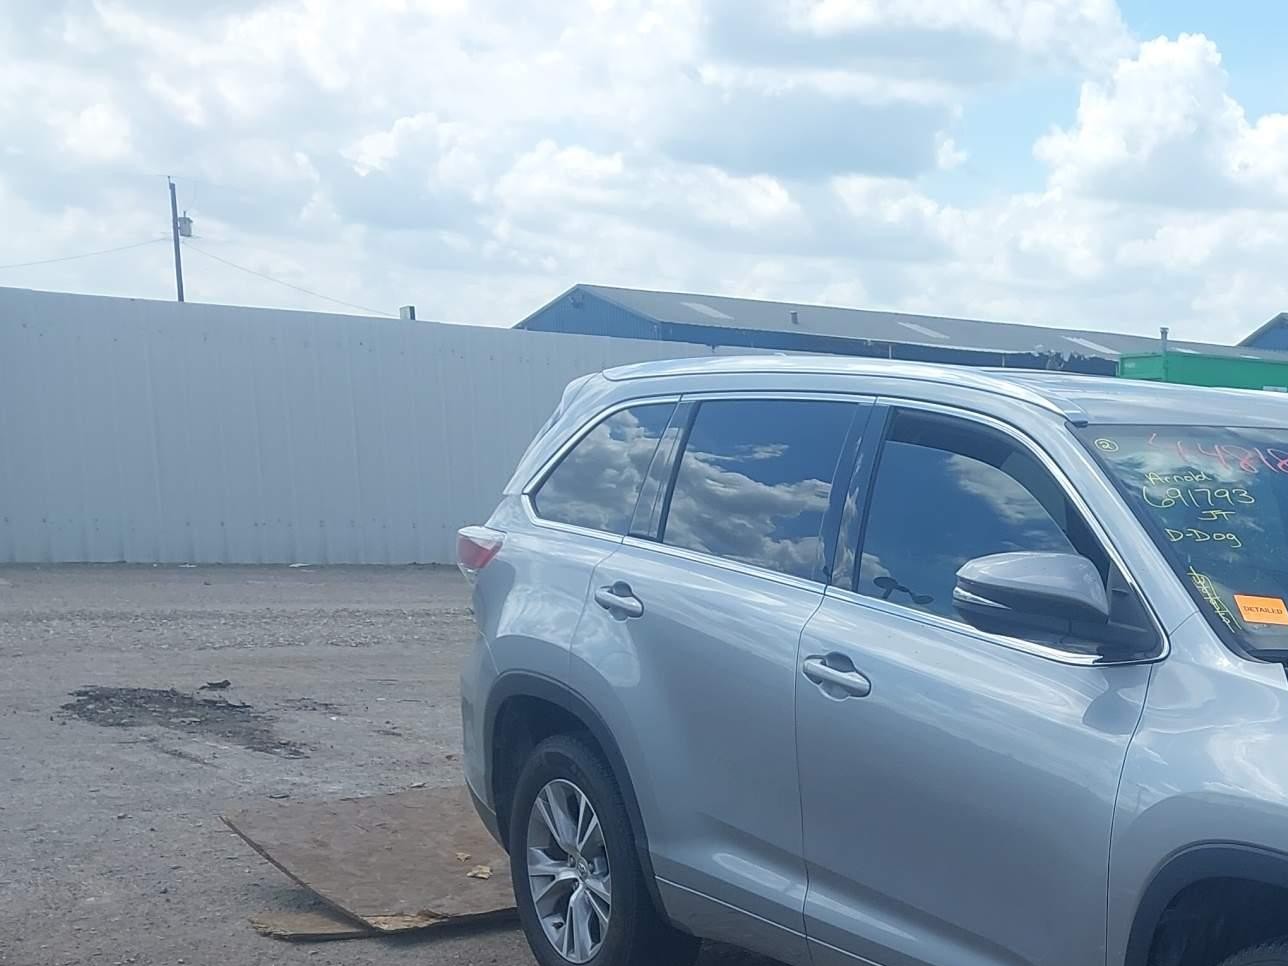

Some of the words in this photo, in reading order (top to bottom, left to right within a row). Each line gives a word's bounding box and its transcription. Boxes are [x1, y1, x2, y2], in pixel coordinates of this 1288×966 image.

[1144, 471, 1213, 486] Arnold
[1142, 486, 1255, 508] 691793
[1164, 527, 1242, 548] D-Dog
[1242, 604, 1284, 615] DETAILED
